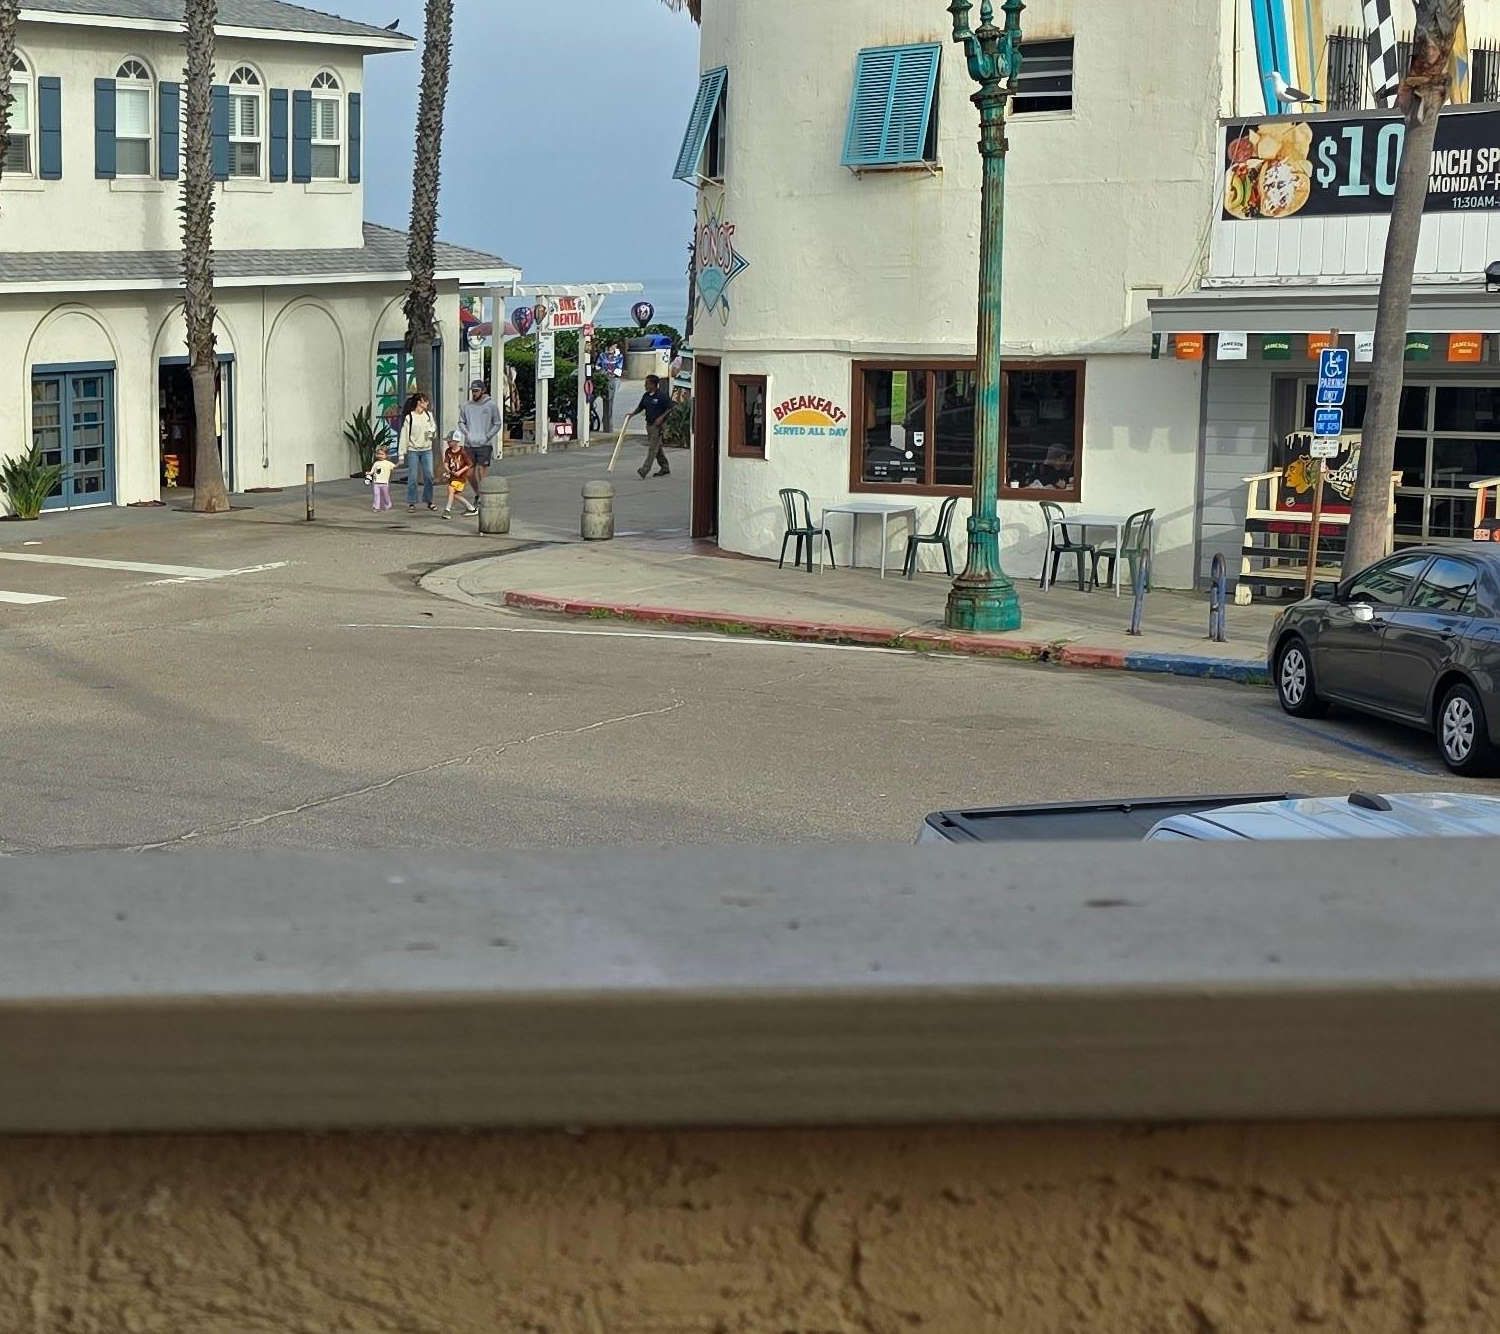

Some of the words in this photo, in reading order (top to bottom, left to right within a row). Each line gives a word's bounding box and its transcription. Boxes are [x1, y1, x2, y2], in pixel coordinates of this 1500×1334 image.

[1316, 122, 1406, 197] $10
[558, 298, 577, 311] BIKE
[553, 312, 582, 327] RENTAL
[1178, 341, 1200, 349] JAMESON
[1263, 342, 1289, 350] JAMESON
[1451, 341, 1479, 349] JAMESON
[1320, 377, 1345, 389] PARKING
[1322, 390, 1339, 402] ONLY
[772, 394, 847, 424] BREAKFAST
[773, 424, 806, 436] SERVED
[807, 426, 826, 436] ALL
[828, 427, 849, 437] DAY
